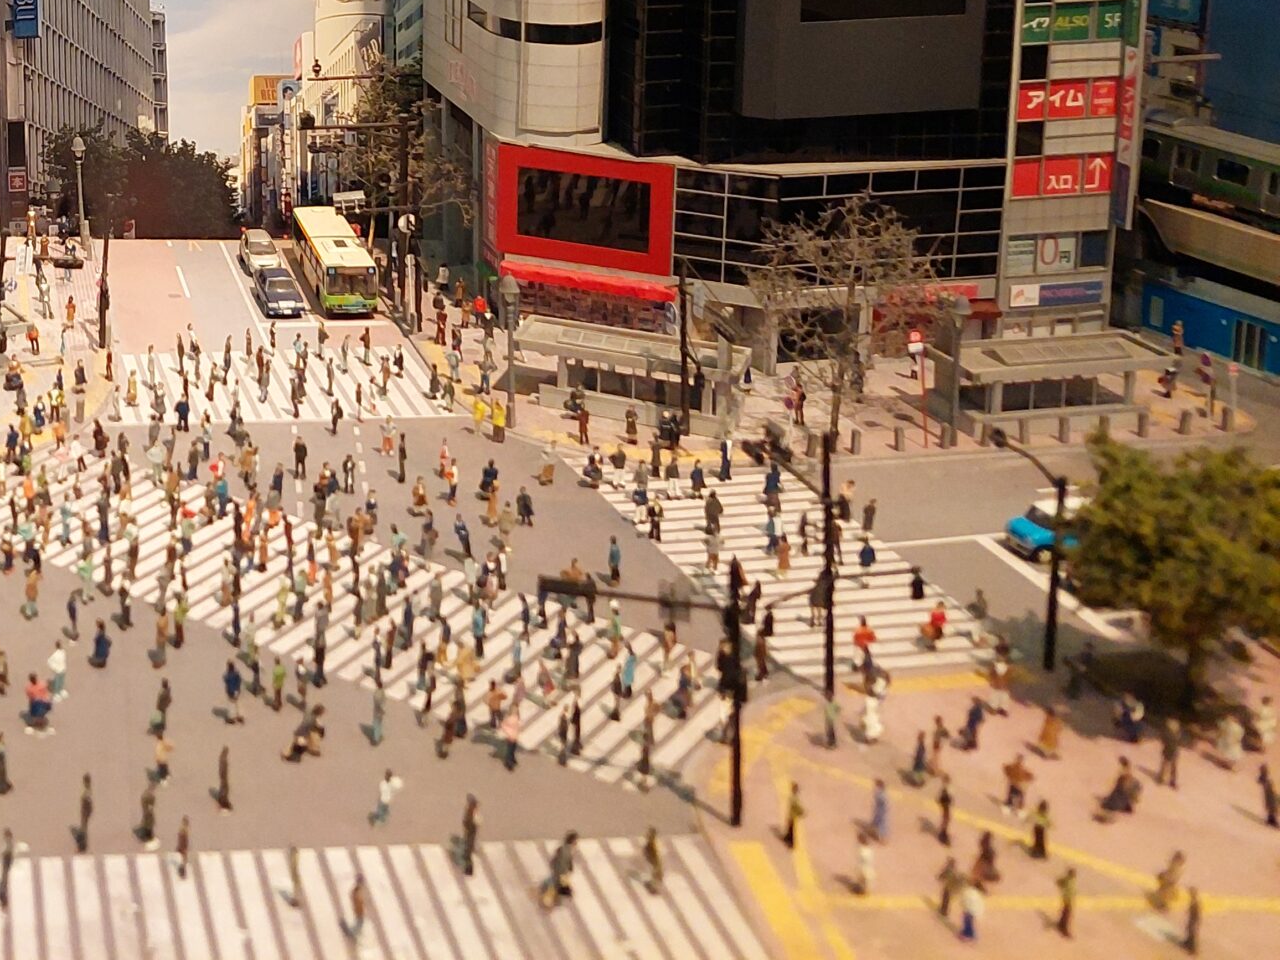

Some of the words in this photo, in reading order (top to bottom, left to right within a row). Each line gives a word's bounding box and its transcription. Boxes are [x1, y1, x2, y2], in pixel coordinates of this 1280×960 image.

[1026, 89, 1084, 109] アイム
[1047, 175, 1073, 190] 入口
